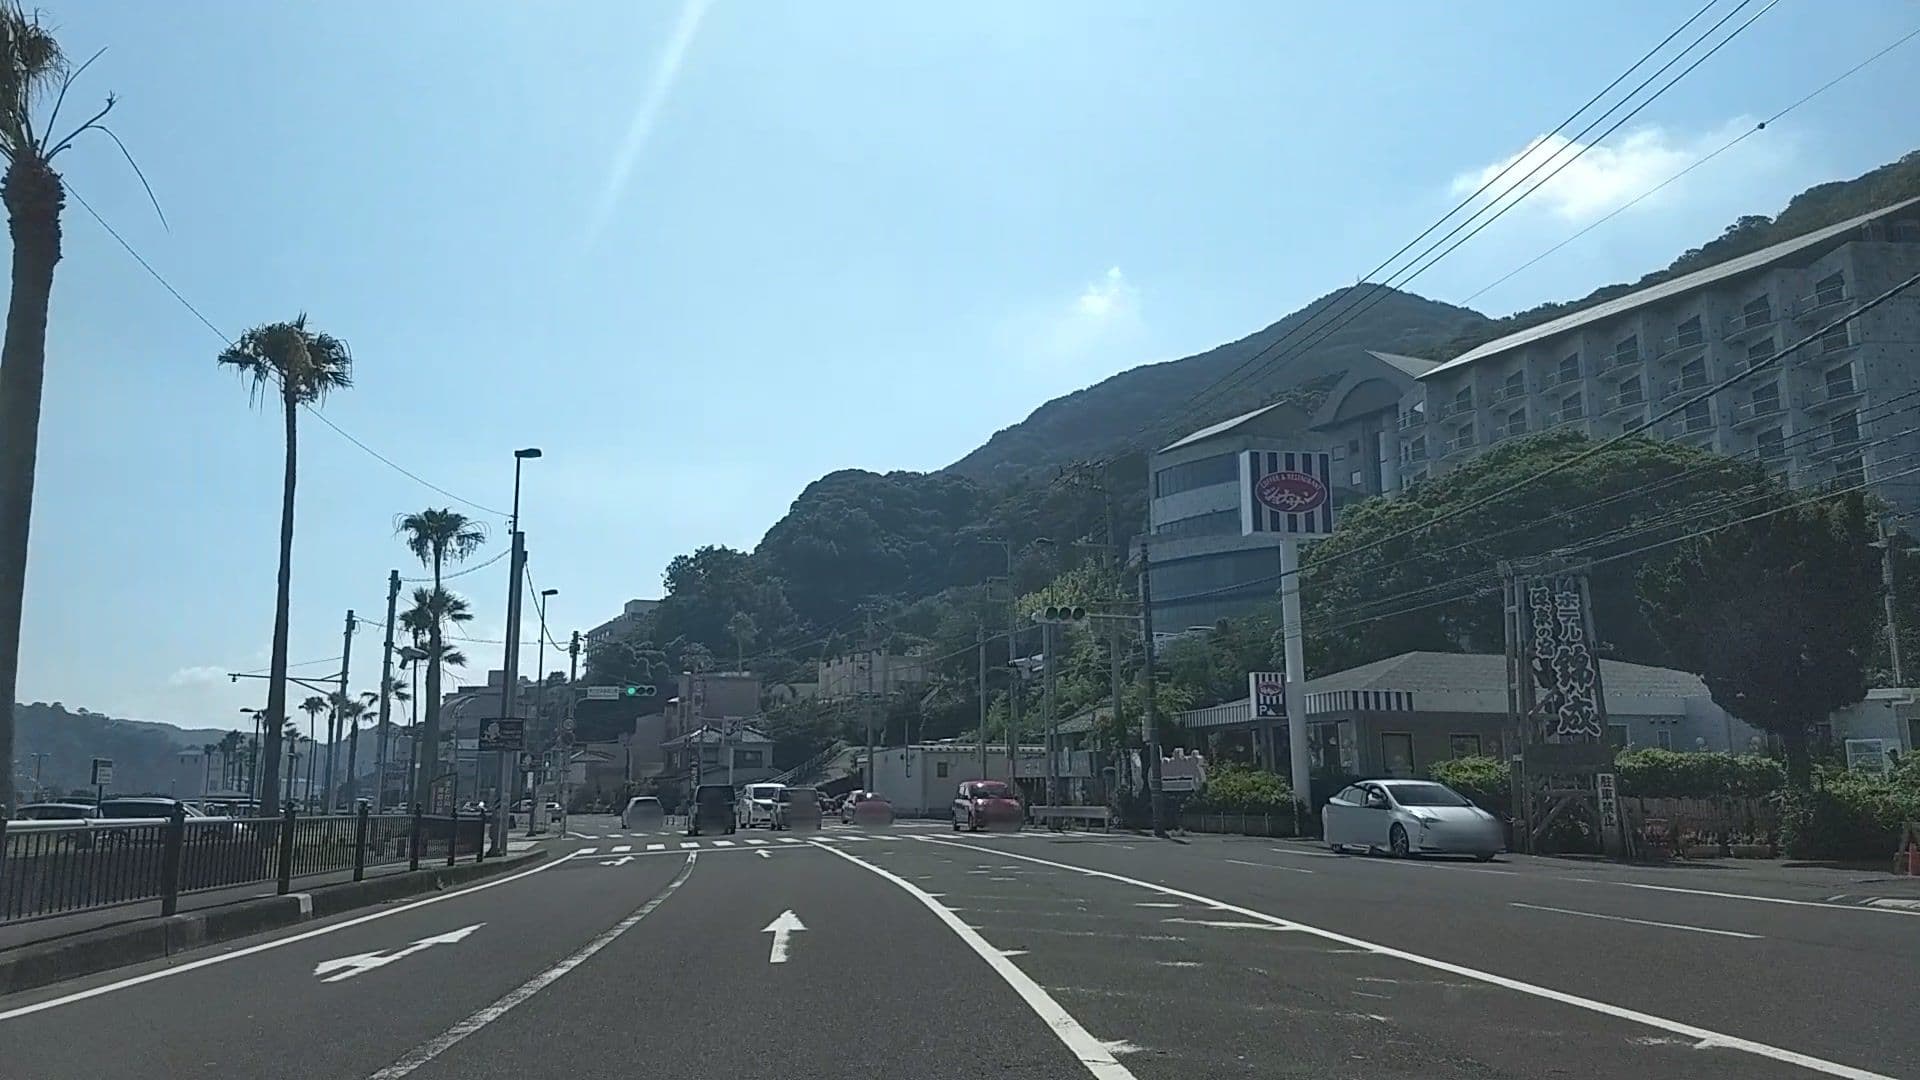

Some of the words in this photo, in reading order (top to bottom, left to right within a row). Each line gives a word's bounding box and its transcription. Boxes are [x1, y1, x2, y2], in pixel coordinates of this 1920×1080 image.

[1259, 704, 1268, 715] P
[1600, 775, 1616, 826] 駐車禁止
